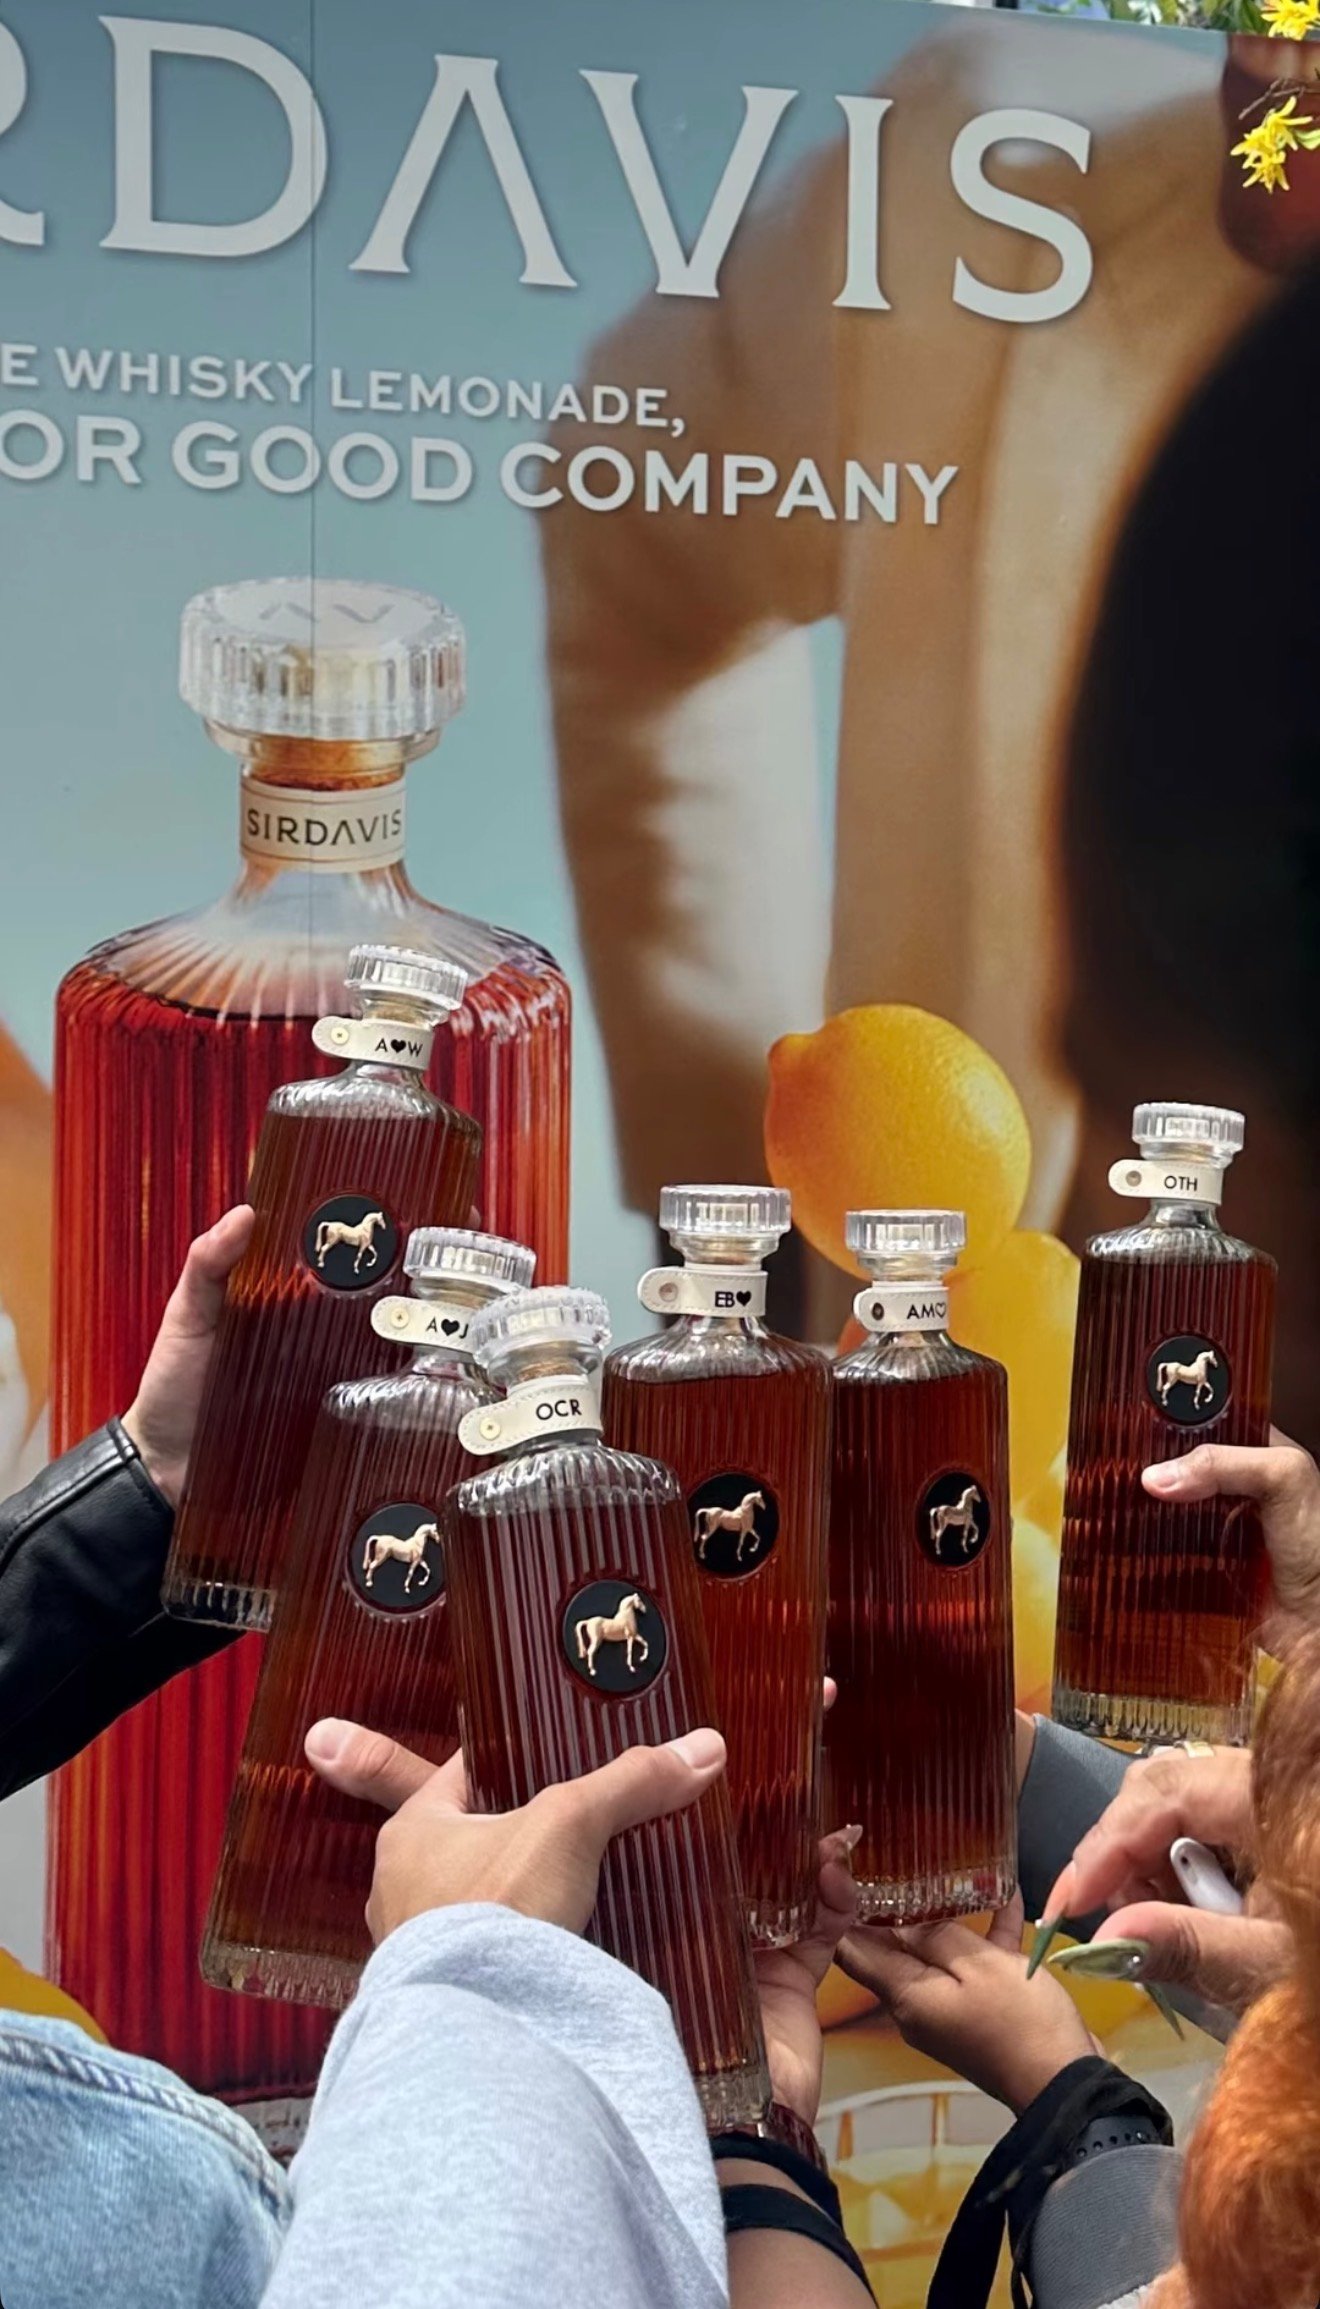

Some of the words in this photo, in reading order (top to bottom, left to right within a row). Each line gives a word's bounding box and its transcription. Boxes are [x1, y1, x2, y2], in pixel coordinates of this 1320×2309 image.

[0, 16, 1093, 323] DAVIS
[54, 346, 313, 403] WHISKY
[331, 367, 685, 437] LEMONADE,
[171, 420, 472, 501] GOOD
[500, 442, 959, 525] COMPANY
[1164, 1175, 1198, 1192] OTH
[535, 1399, 582, 1420] OCR
